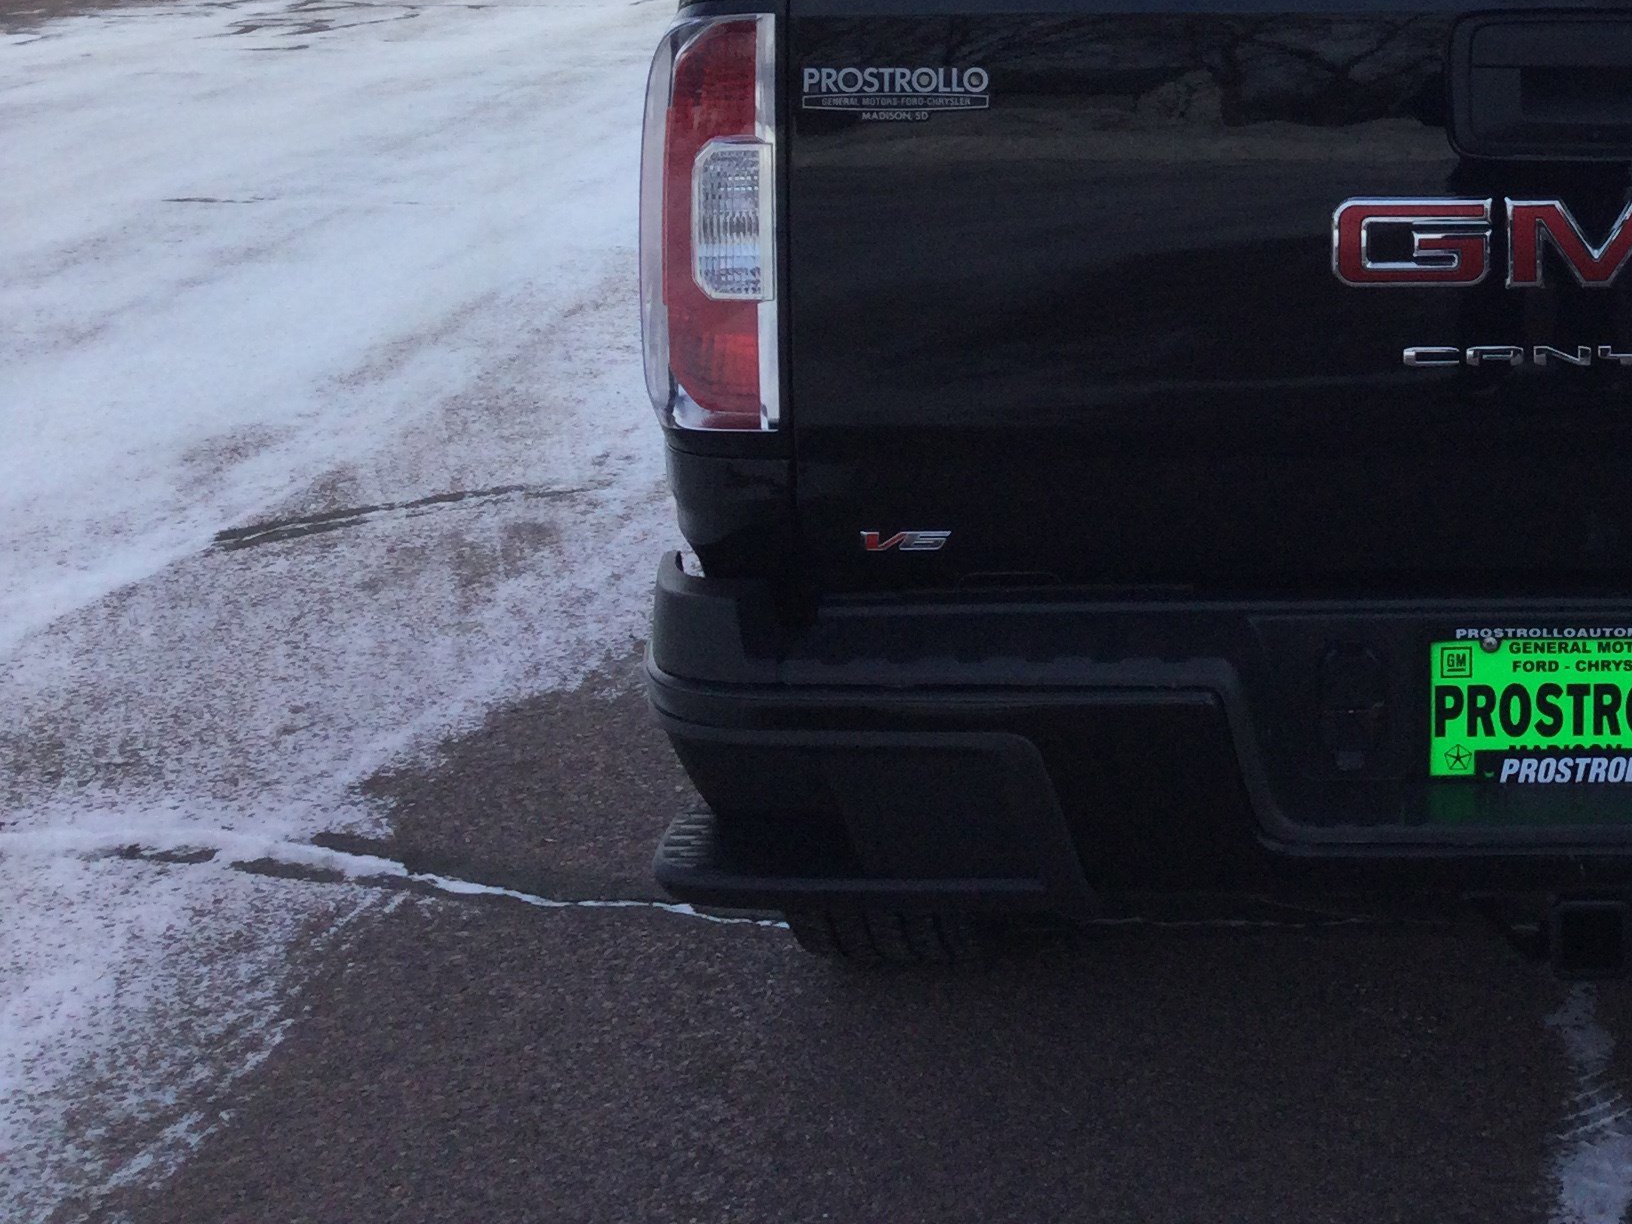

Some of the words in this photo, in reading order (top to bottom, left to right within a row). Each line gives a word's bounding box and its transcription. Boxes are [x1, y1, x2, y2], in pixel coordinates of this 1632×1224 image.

[803, 67, 989, 92] PROSTROLLO
[821, 97, 860, 106] GENERAL
[915, 111, 929, 121] SD
[860, 530, 952, 551] V6
[1508, 640, 1593, 654] GENERAL
[1446, 652, 1467, 669] GM
[1512, 659, 1560, 673] FORD
